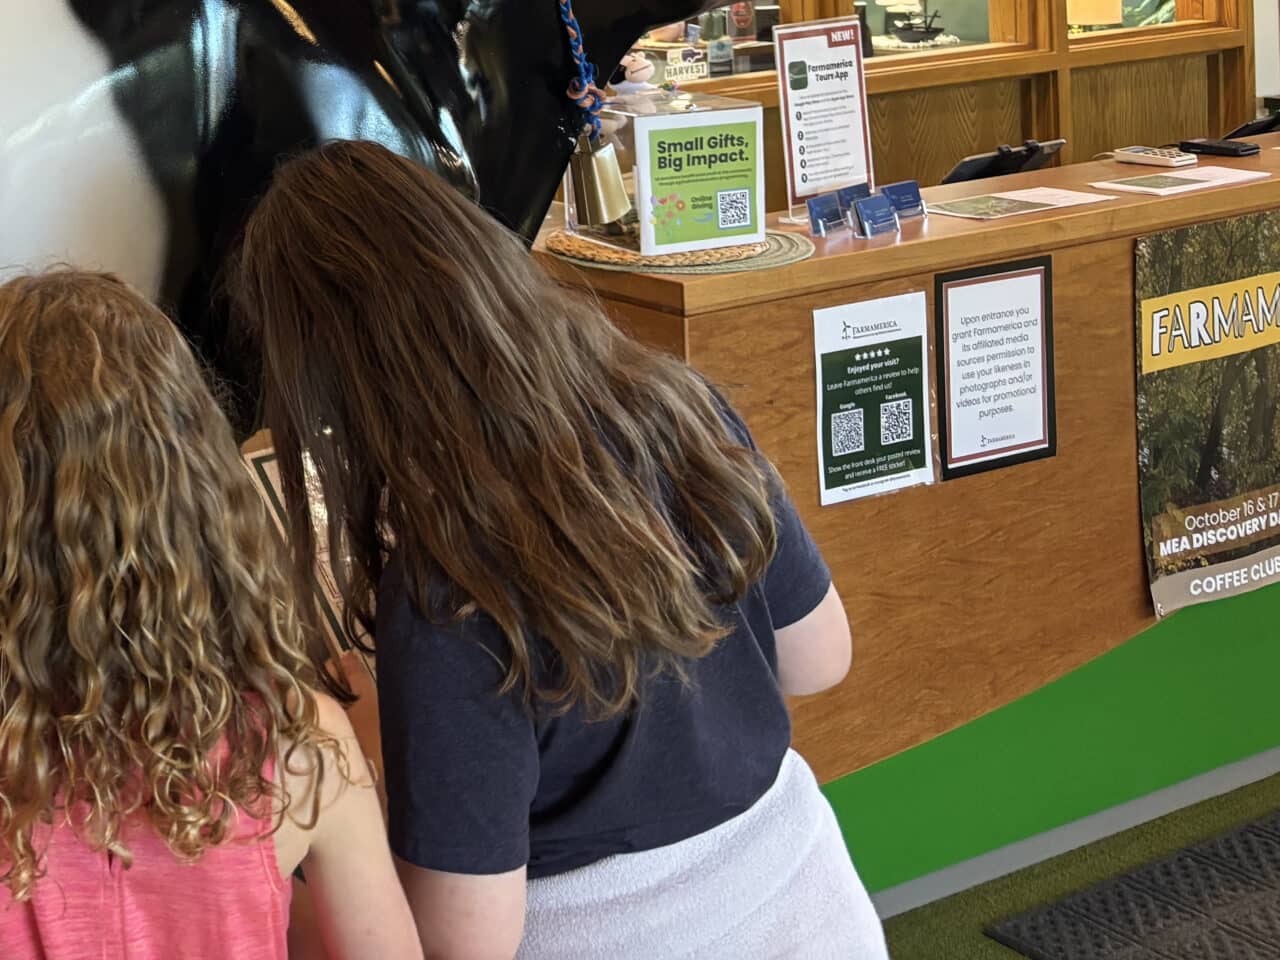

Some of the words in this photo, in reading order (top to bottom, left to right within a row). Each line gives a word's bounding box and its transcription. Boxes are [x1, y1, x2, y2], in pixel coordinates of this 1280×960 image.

[830, 28, 855, 43] NEW!
[665, 64, 707, 78] HARVEST
[807, 59, 854, 73] Farmamerica
[815, 73, 834, 82] Tours
[835, 71, 849, 82] App
[656, 136, 704, 154] Small
[707, 133, 749, 150] Gifts,
[657, 153, 683, 172] Big
[686, 149, 749, 169] Impact.
[960, 315, 980, 327] Upon
[981, 309, 1014, 323] entrance
[1015, 306, 1030, 318] you
[1150, 282, 1280, 357] FARMAM
[852, 320, 898, 336] FARMAMERICA
[951, 329, 972, 343] grant
[973, 319, 1023, 337] Farmamerica
[1023, 317, 1038, 328] and
[961, 343, 971, 352] its
[972, 336, 1004, 351] affiliated
[1005, 333, 1029, 345] media
[847, 363, 870, 375] Enjoyed
[870, 361, 884, 372] your
[884, 357, 900, 368] visit?
[956, 355, 985, 367] sources
[986, 347, 1026, 364] permission
[1026, 345, 1035, 354] to
[961, 371, 975, 380] use
[976, 368, 992, 380] your
[993, 361, 1022, 374] likeness
[1023, 359, 1031, 369] in
[959, 378, 1007, 396] photographs
[1008, 371, 1033, 386] and/or
[955, 397, 981, 409] videos
[982, 393, 992, 404] for
[993, 384, 1037, 403] promotional
[1184, 507, 1241, 531] October
[1242, 500, 1255, 517] 16
[1256, 497, 1267, 512] &
[1268, 492, 1279, 509] 17
[1159, 535, 1191, 557] MEA
[1192, 514, 1268, 549] DISCOVERY
[1190, 568, 1249, 596] COFFEE
